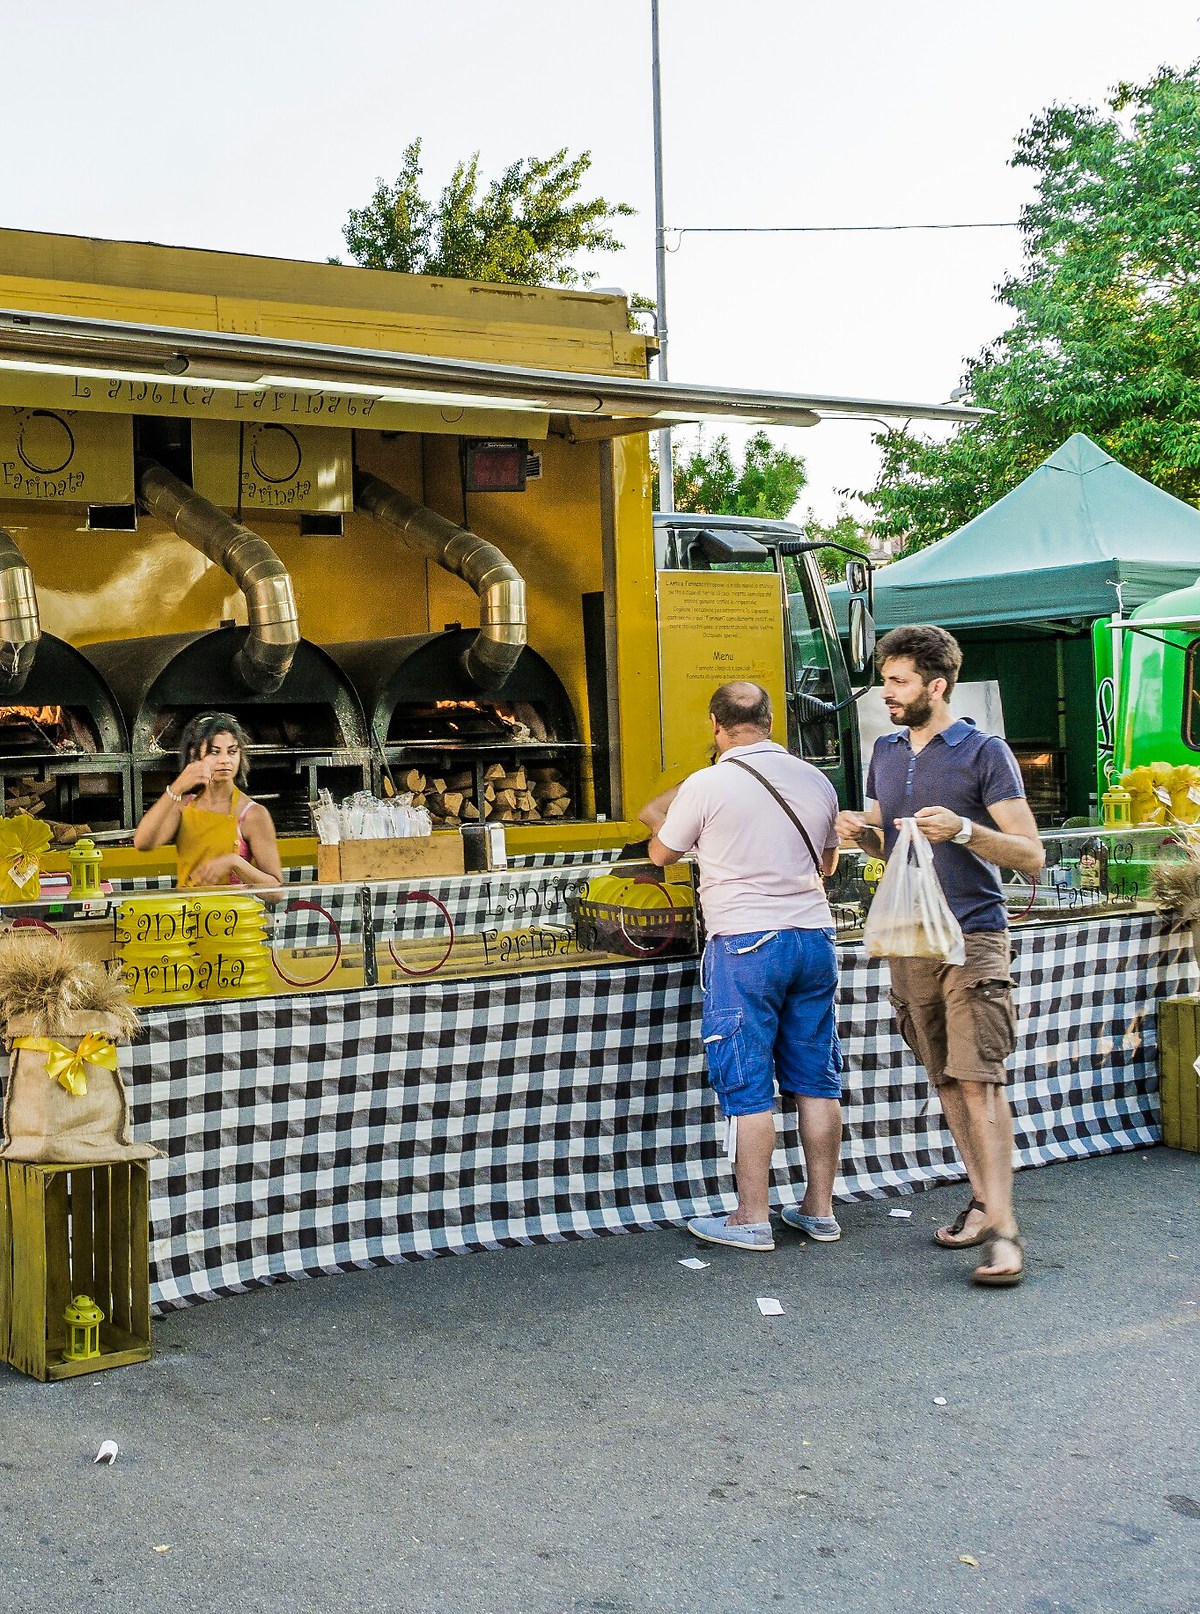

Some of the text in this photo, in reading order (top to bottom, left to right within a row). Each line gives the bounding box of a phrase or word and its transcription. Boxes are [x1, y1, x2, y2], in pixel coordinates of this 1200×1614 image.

[2, 462, 85, 498] Farinata
[483, 876, 590, 916] L'antica
[1055, 876, 1139, 911] Farinata
[110, 902, 239, 944] L'antica
[479, 921, 598, 965] Farinata
[101, 953, 245, 995] Farinata
